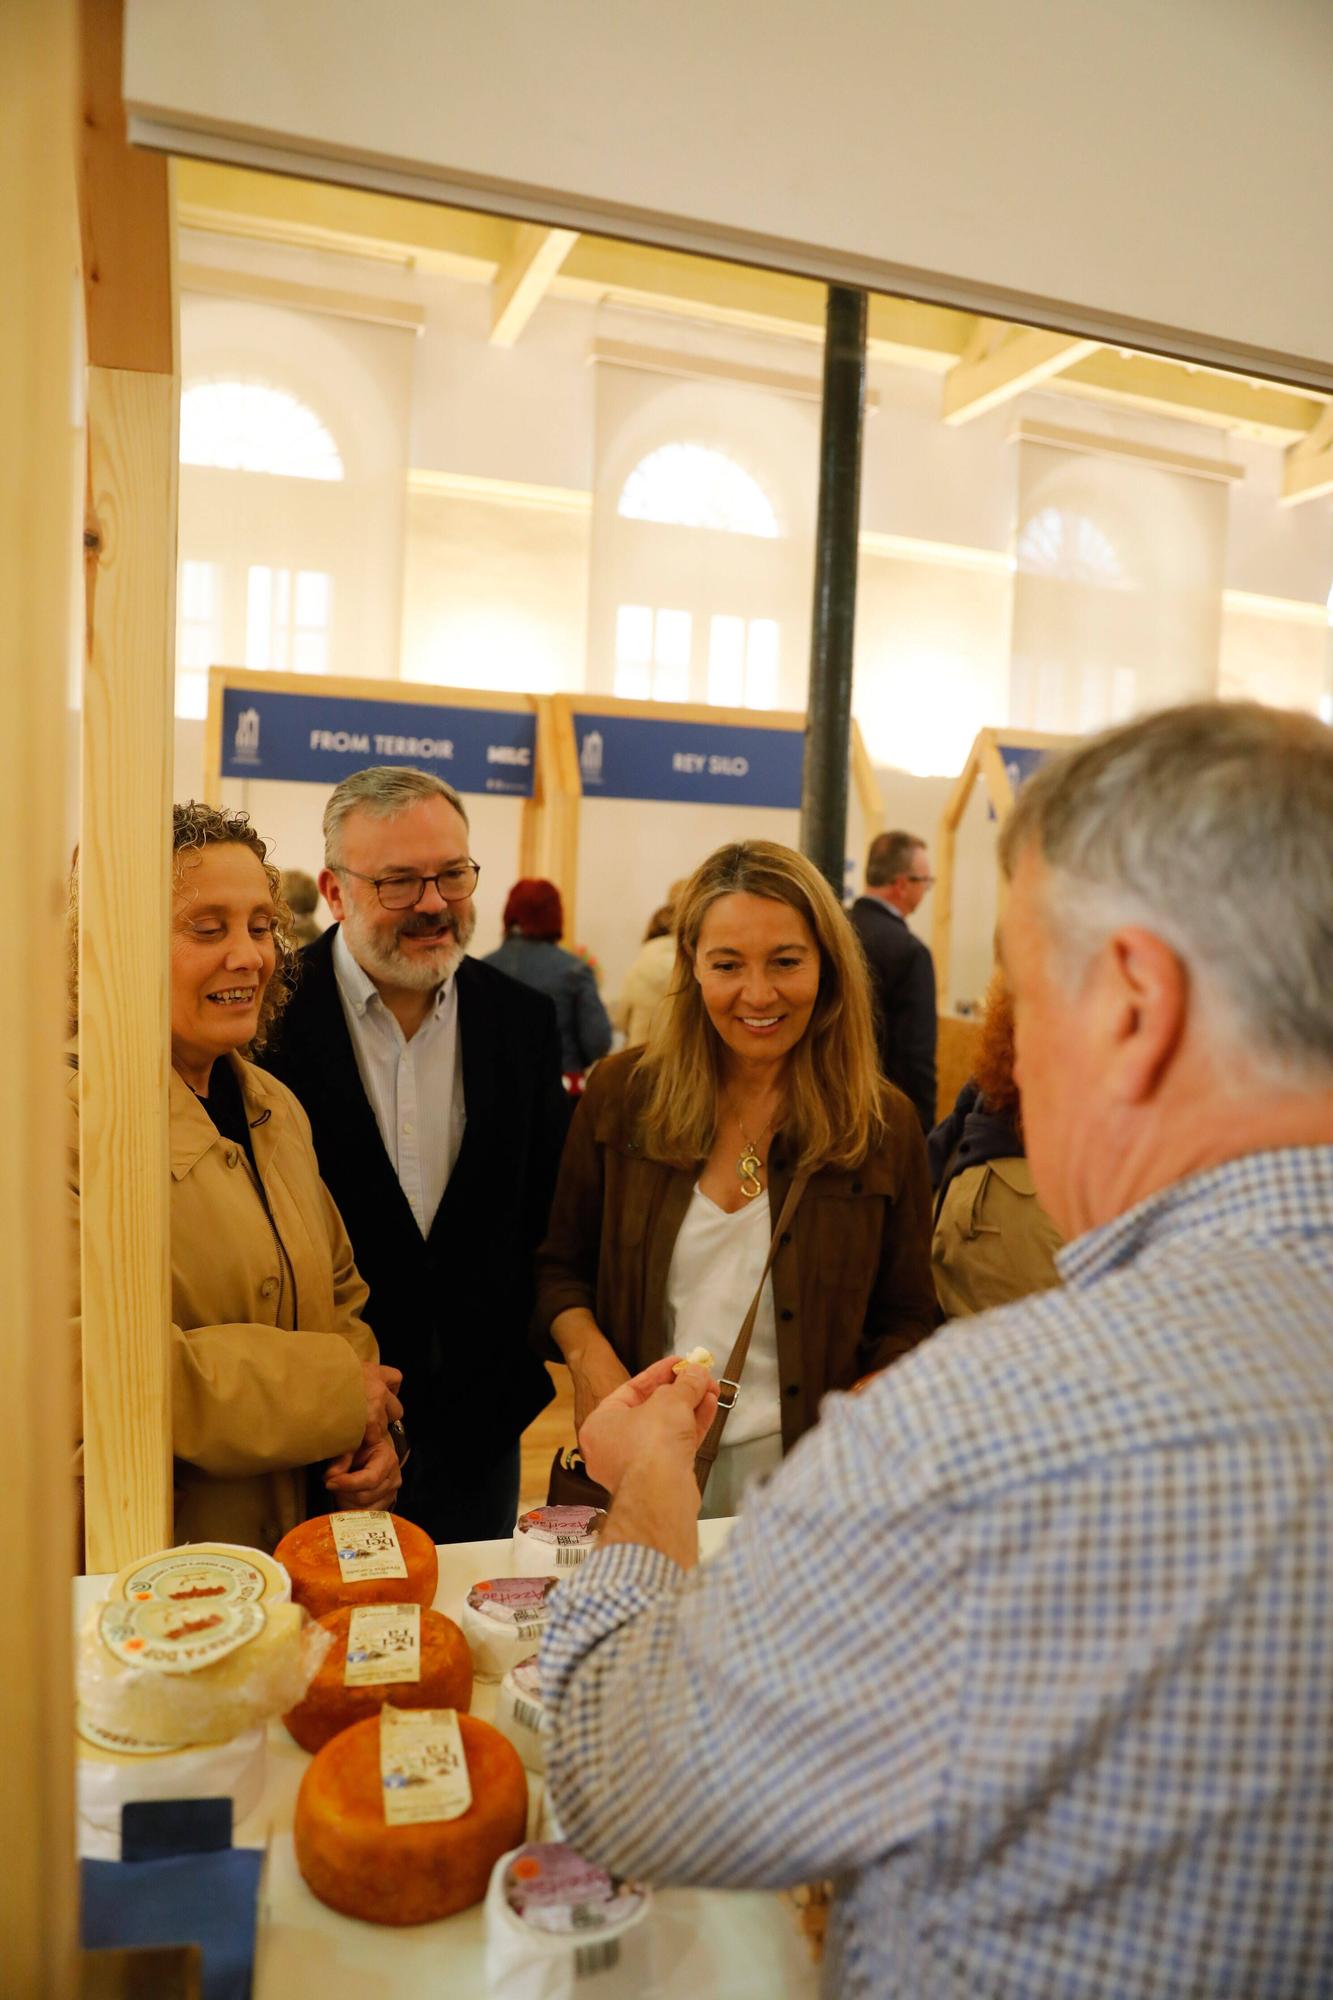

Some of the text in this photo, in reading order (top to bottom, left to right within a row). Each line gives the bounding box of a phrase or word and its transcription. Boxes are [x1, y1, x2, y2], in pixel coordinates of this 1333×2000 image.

[310, 730, 454, 760] FROM TERROIR
[672, 752, 749, 777] REY SILO
